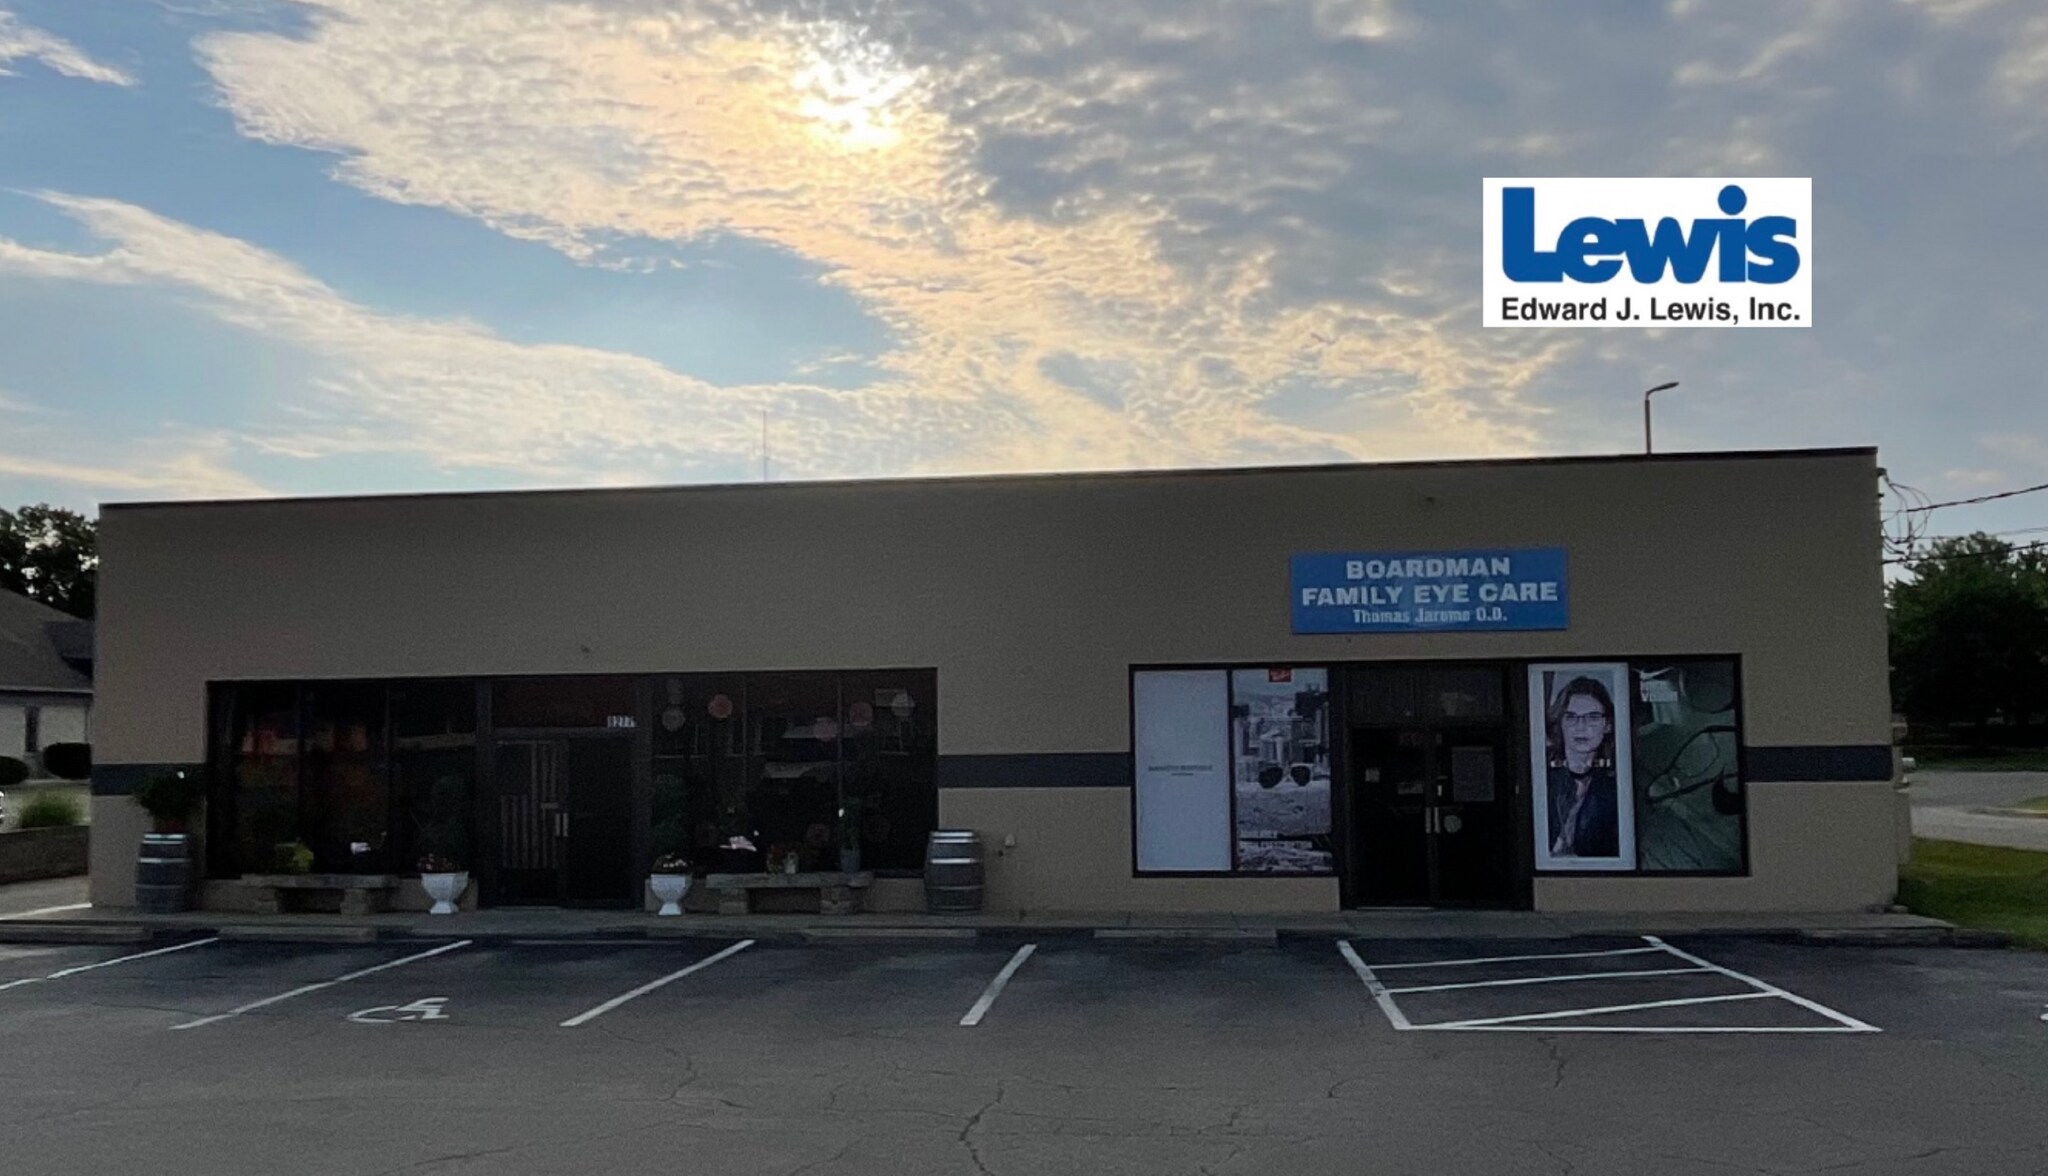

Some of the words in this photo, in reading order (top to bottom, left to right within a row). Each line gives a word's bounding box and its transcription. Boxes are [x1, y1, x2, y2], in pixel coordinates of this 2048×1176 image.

[1346, 557, 1511, 580] BOARDMAN
[1302, 586, 1403, 606] FAMILY
[1414, 584, 1470, 604] EYE
[1479, 581, 1558, 602] CARE
[1353, 609, 1410, 624] Thomas
[1476, 606, 1508, 622] O.D.
